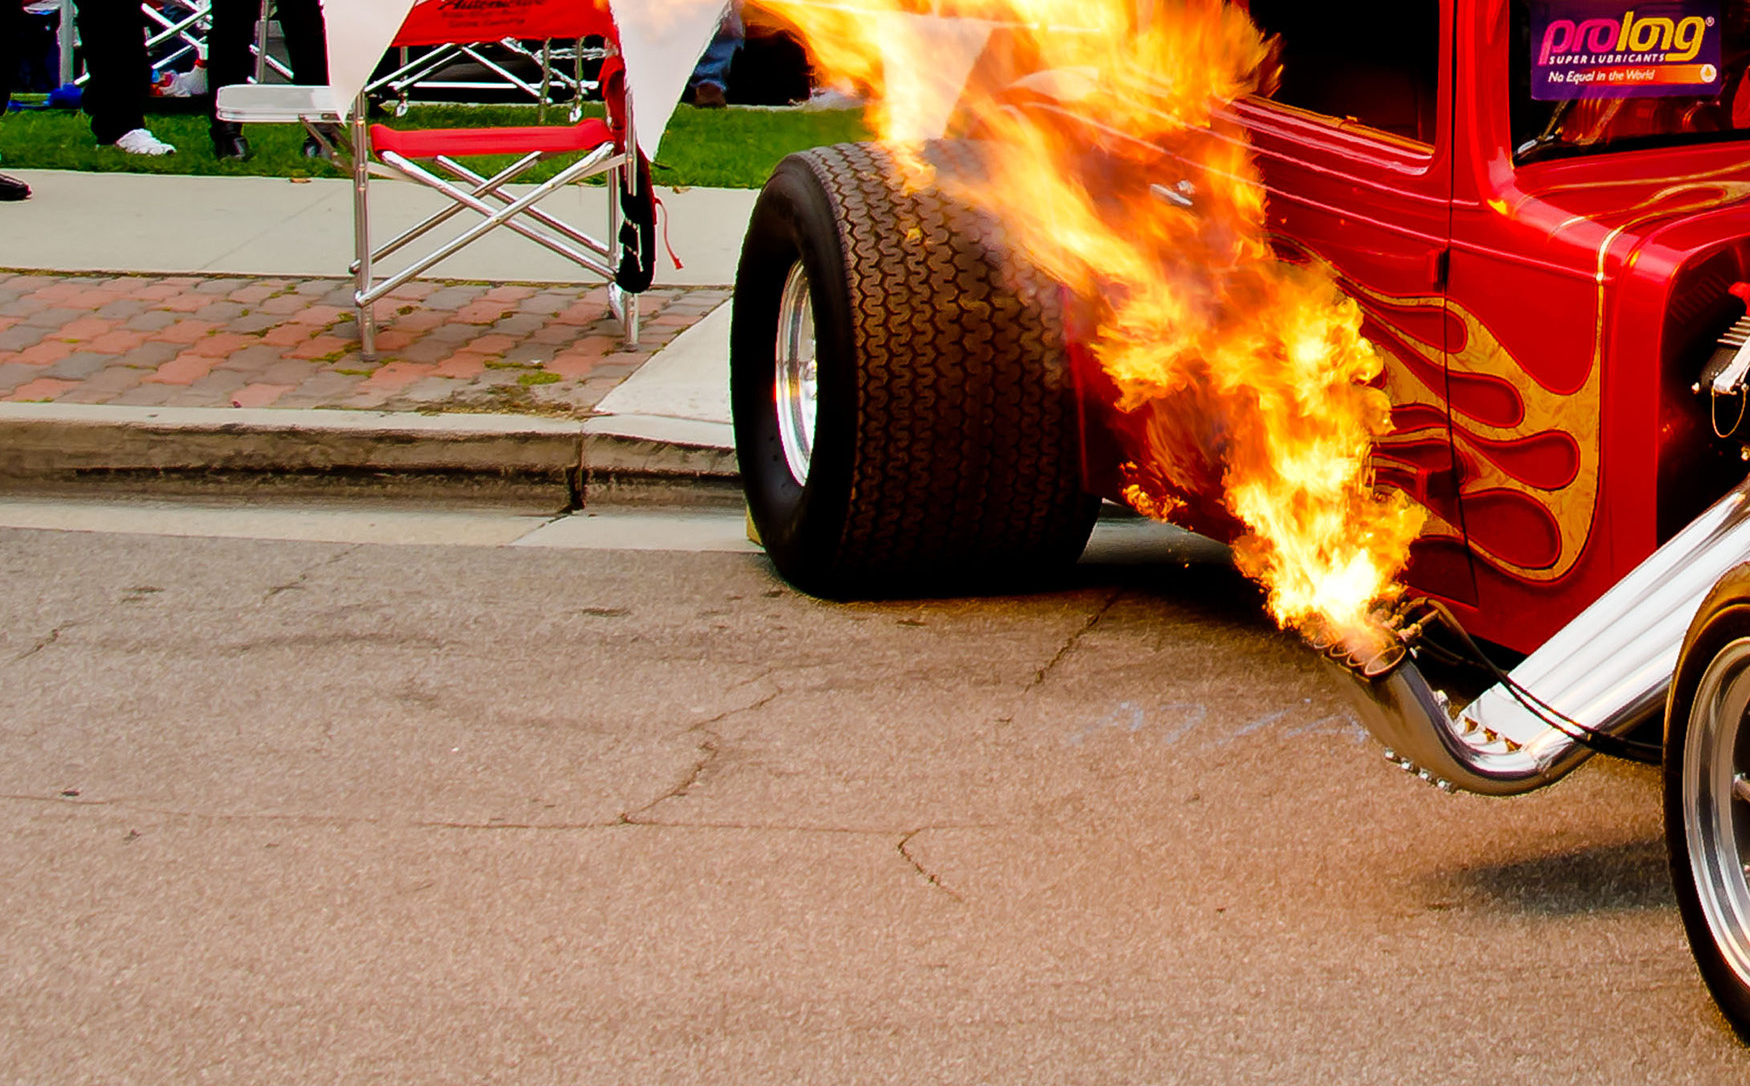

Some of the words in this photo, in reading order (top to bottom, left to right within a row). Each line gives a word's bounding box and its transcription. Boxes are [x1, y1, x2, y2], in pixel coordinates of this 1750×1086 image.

[1537, 11, 1706, 66] prolong
[1549, 55, 1587, 65] SUPER
[1591, 53, 1665, 64] LUBRICANTS
[1548, 71, 1564, 83] No
[1566, 71, 1594, 85] Equal
[1596, 71, 1606, 82] in
[1608, 70, 1624, 81] the
[1626, 69, 1655, 81] World
